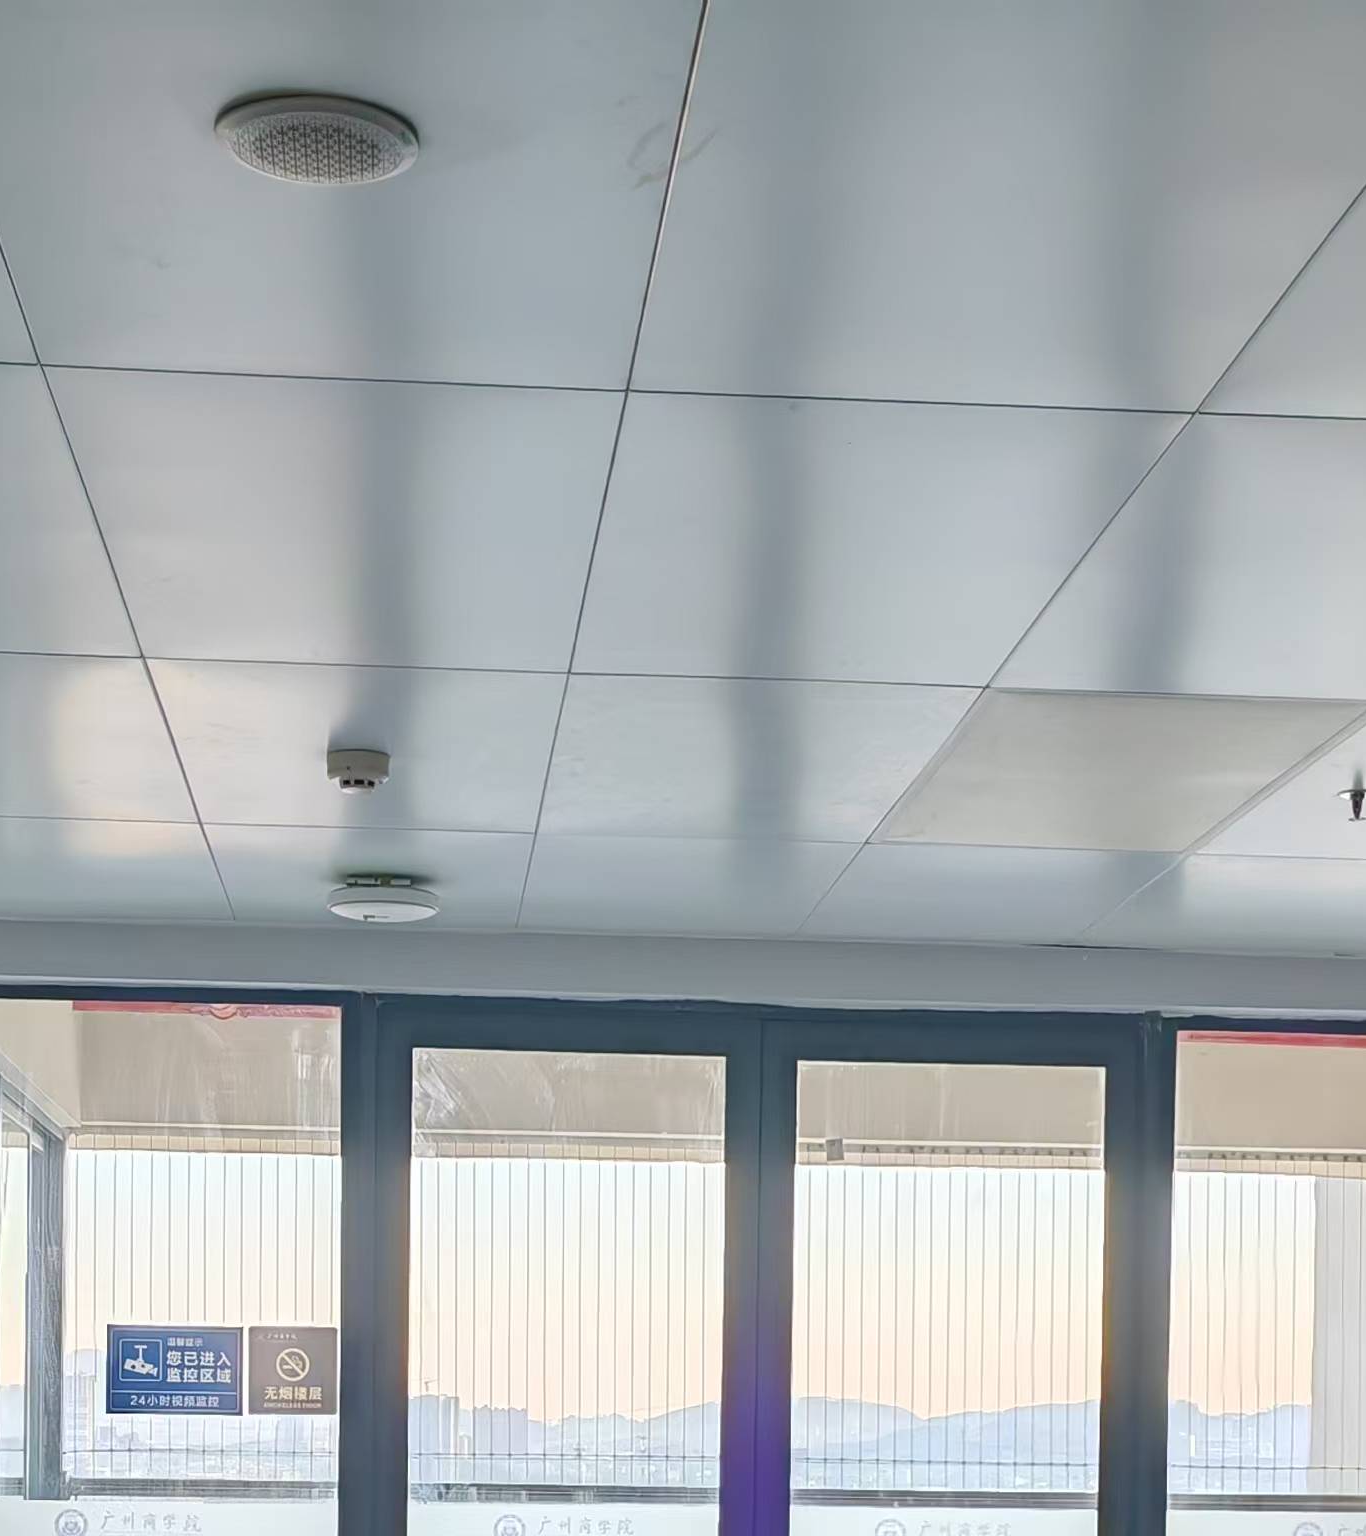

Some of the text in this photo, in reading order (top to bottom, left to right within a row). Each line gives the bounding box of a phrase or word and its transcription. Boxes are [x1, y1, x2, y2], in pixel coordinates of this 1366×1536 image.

[166, 1350, 232, 1367] 您已进入
[166, 1367, 232, 1384] 监控区域
[130, 1394, 220, 1408] 24小时视频监控
[263, 1386, 323, 1401] 无烟楼层
[100, 1510, 202, 1532] 广州商学院
[538, 1516, 635, 1536] 广州商学院
